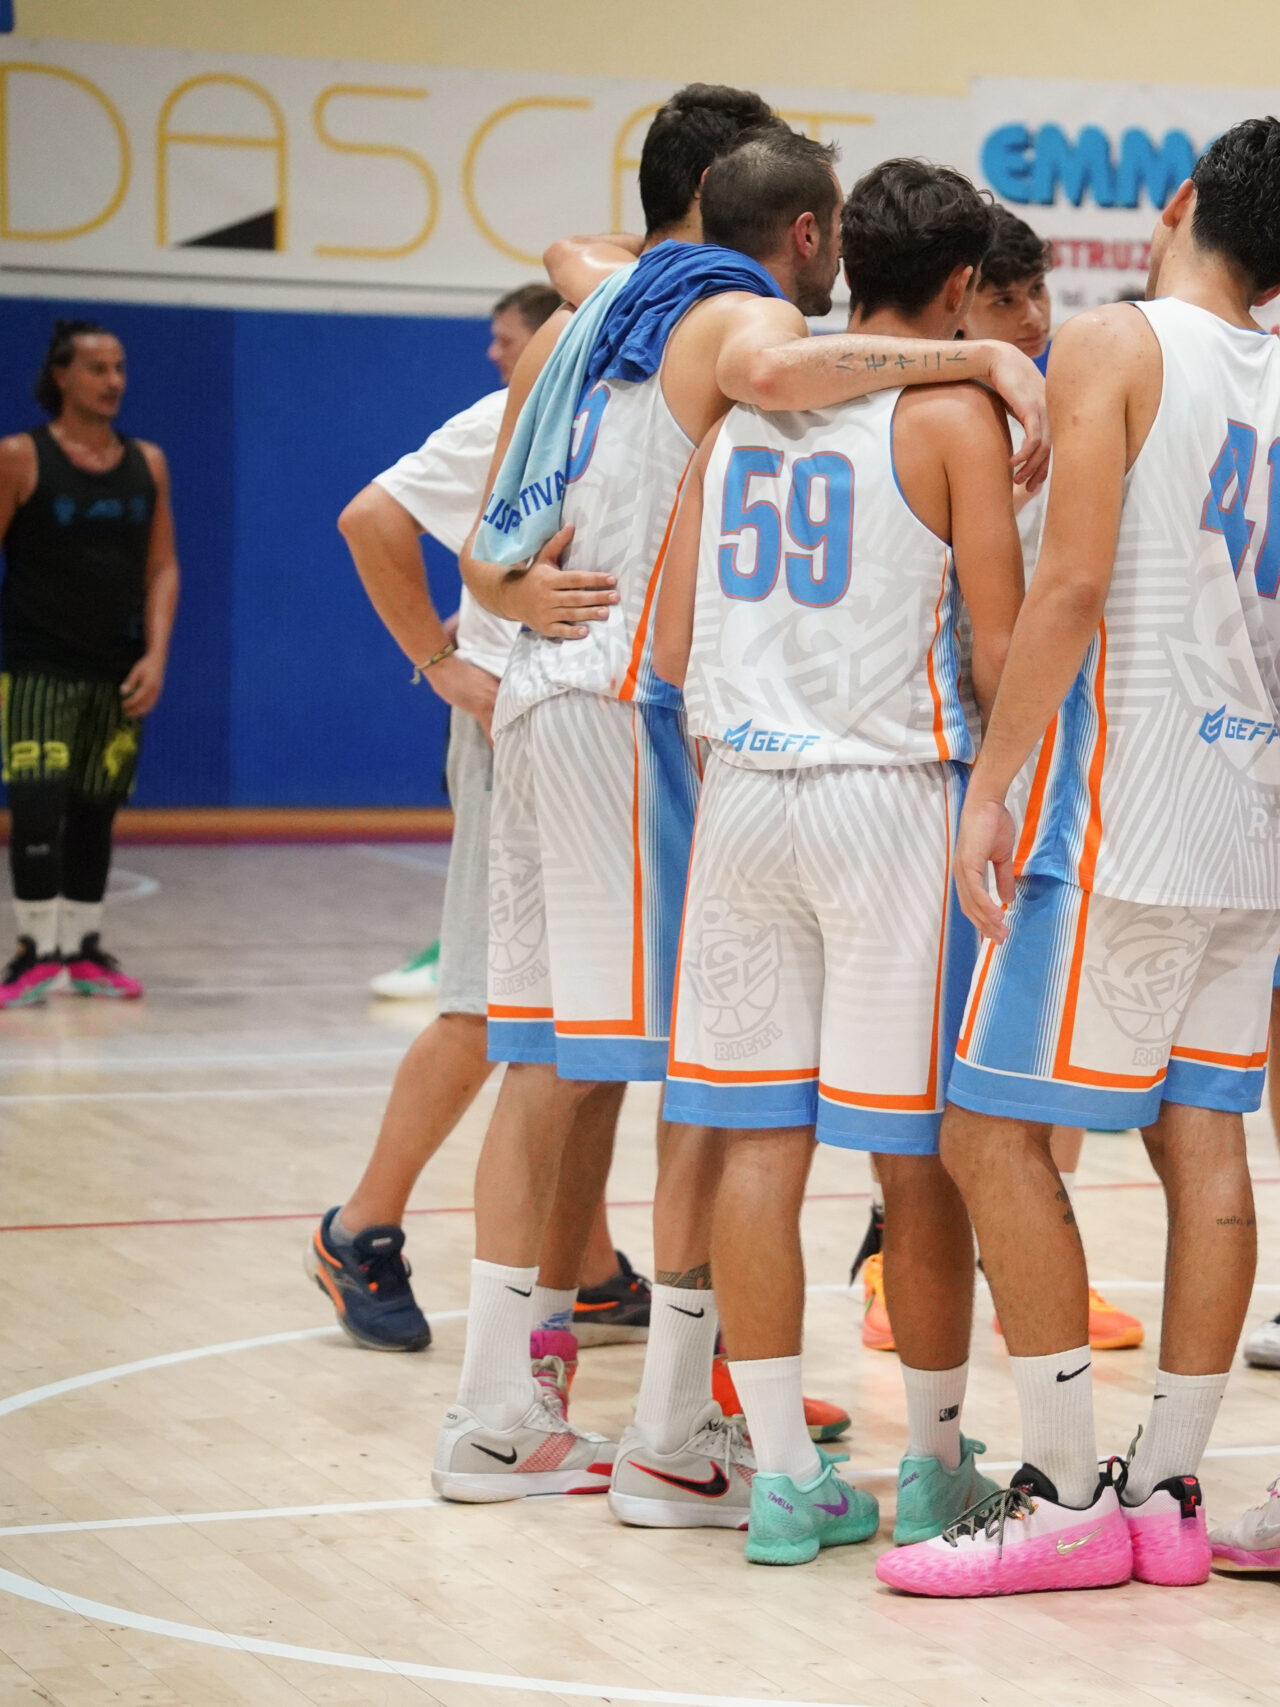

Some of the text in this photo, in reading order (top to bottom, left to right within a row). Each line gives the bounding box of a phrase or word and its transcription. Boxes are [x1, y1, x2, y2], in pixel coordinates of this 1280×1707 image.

[718, 446, 855, 608] 59
[749, 730, 821, 752] GEFF
[714, 1021, 784, 1061] RIETI
